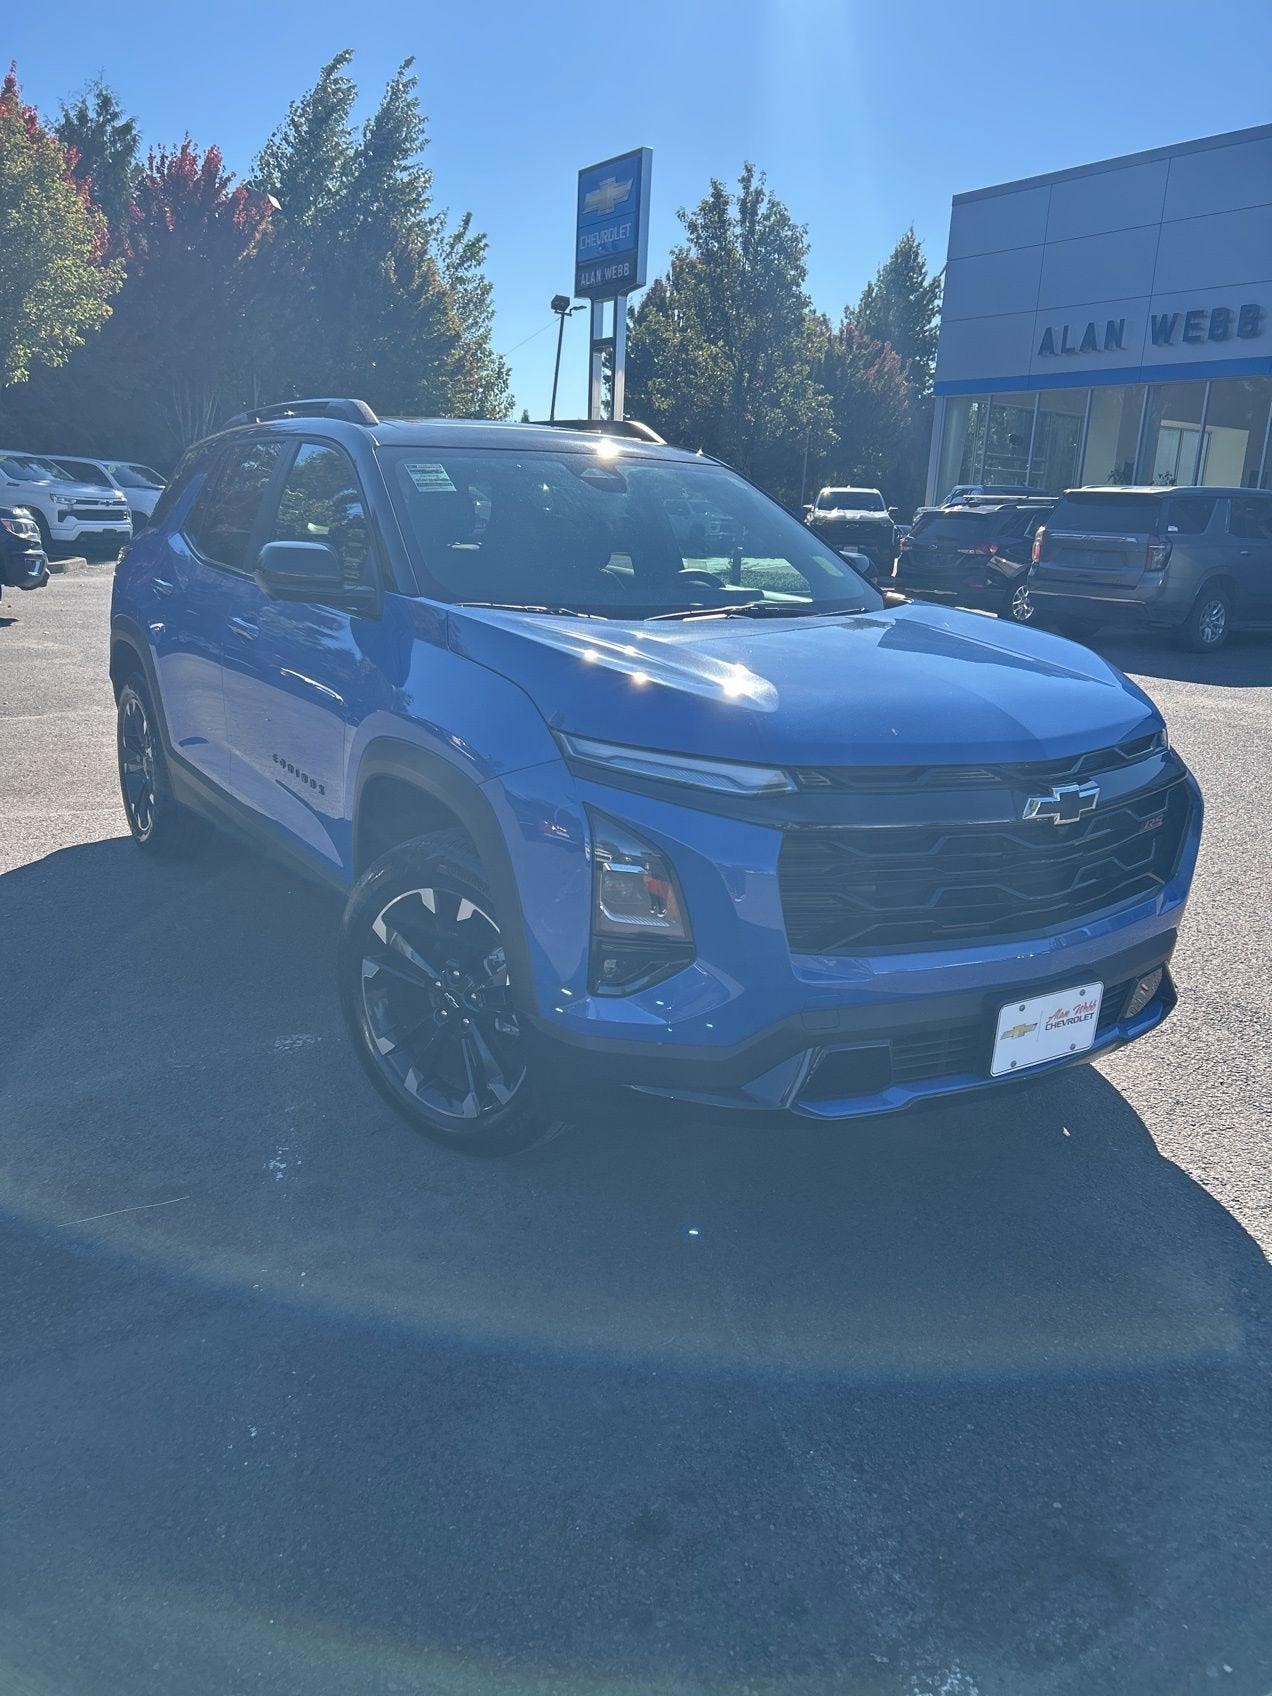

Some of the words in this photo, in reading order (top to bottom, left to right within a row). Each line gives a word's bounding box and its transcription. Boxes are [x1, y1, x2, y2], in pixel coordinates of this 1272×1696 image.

[580, 223, 632, 250] CHEVROLET
[580, 269, 602, 286] ALAN
[604, 263, 630, 280] WEBB
[1038, 318, 1127, 356] ALAN
[1151, 304, 1265, 346] WEBB
[1045, 1008, 1070, 1024] Alan
[1073, 999, 1098, 1016] Webb
[1045, 1012, 1094, 1031] CHEVROLET
